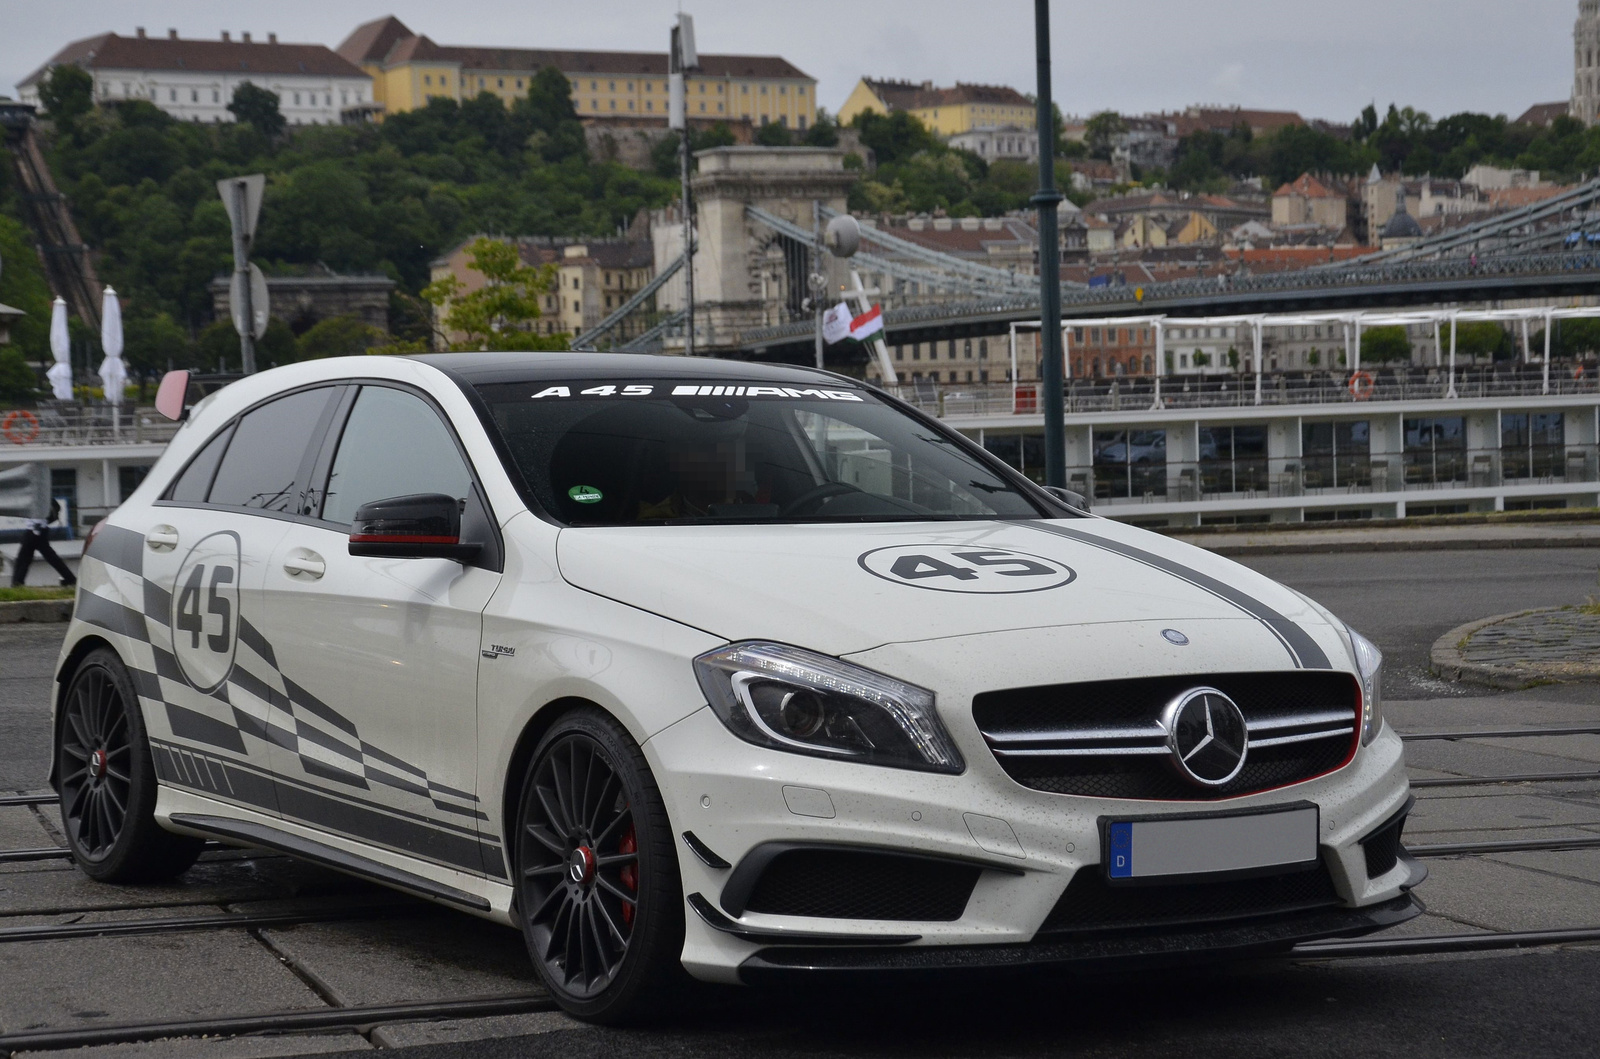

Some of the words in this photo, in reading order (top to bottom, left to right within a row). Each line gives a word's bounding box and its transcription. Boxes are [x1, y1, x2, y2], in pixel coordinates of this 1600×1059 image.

[531, 386, 571, 398] A
[580, 385, 654, 396] 45
[746, 387, 864, 402] AMG
[580, 486, 589, 494] 4
[890, 551, 1058, 581] 45
[177, 563, 234, 653] 45
[1116, 855, 1125, 867] D
